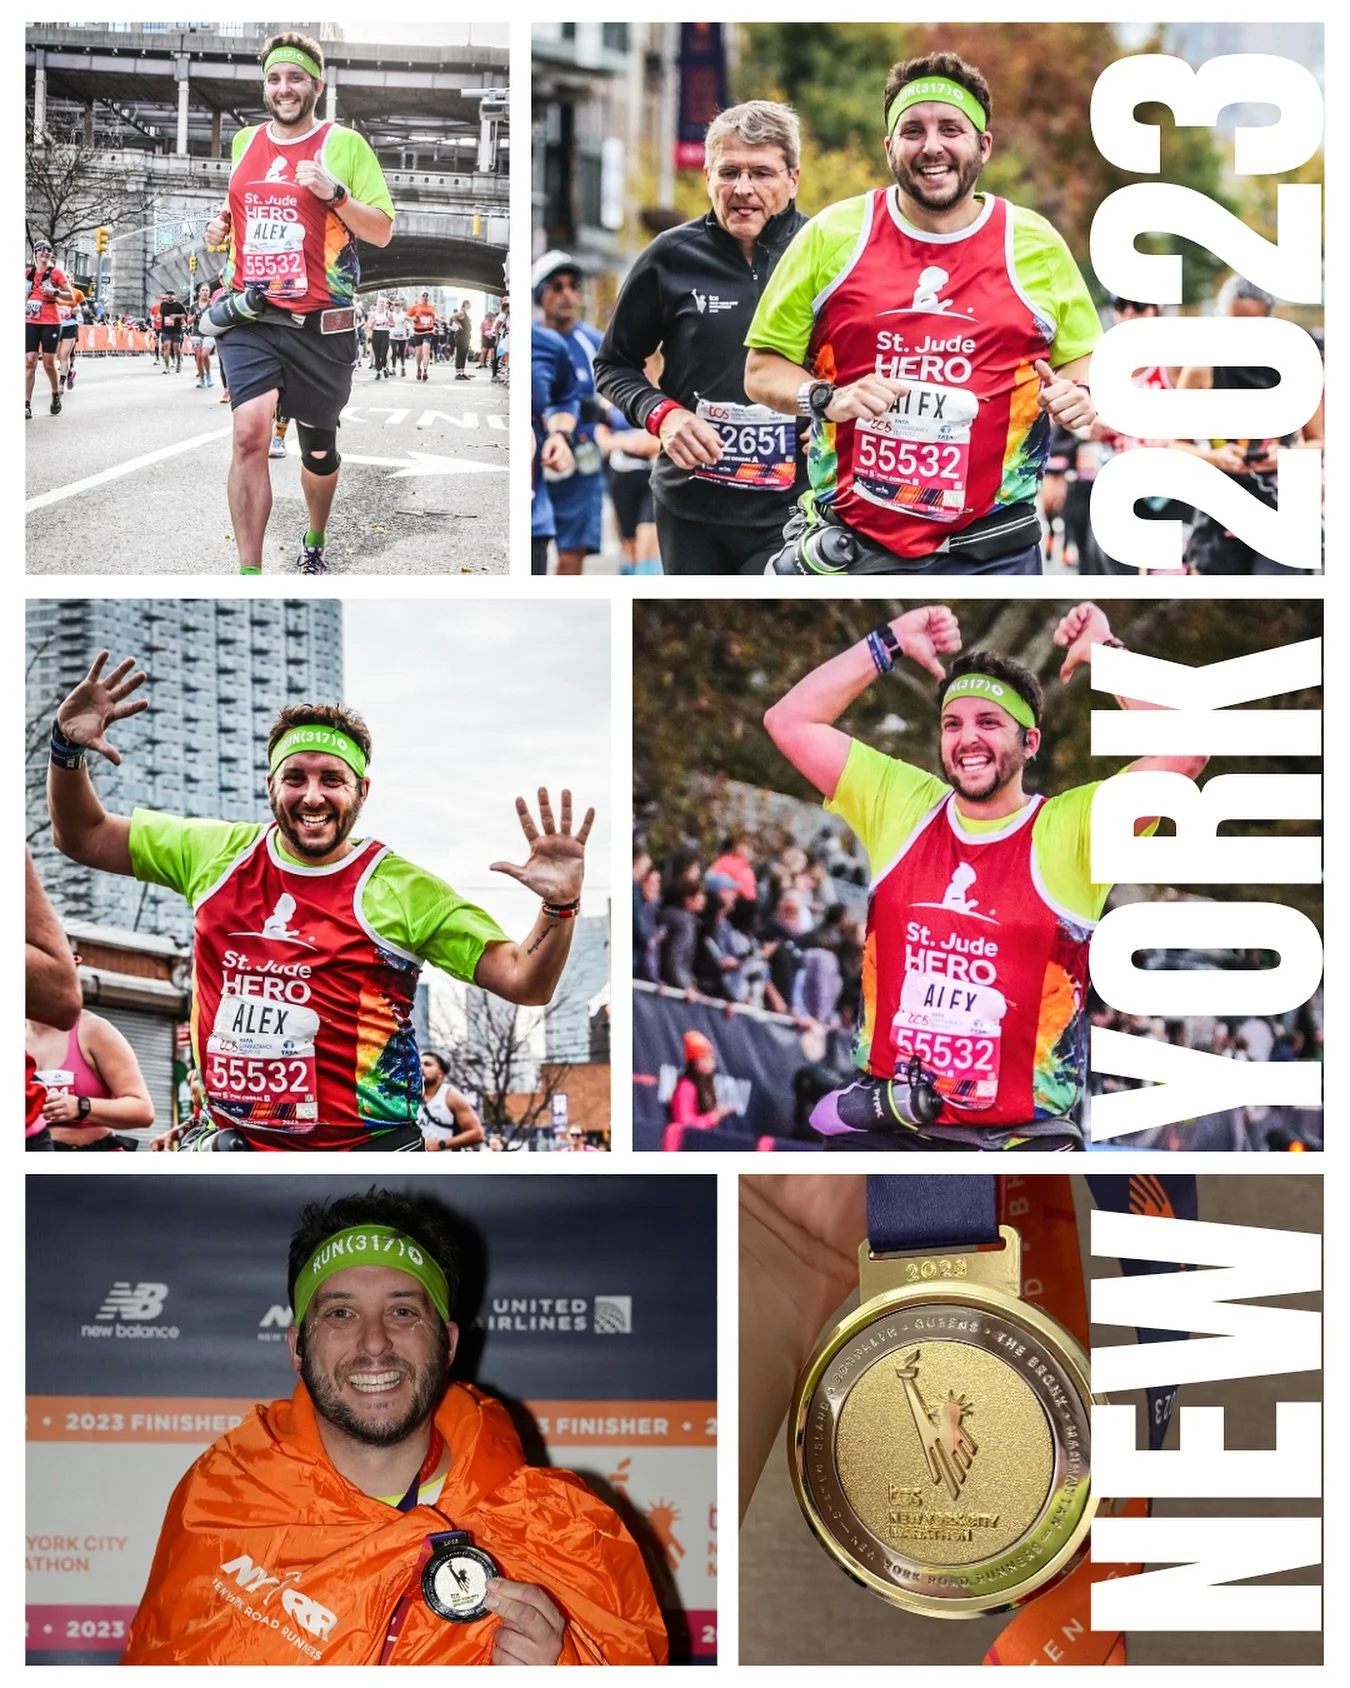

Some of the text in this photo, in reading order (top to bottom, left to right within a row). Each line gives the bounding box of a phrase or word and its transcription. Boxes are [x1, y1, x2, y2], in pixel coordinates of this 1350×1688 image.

[245, 193, 297, 206] St. Jude
[245, 206, 298, 221] HERO
[254, 223, 288, 240] ALEX
[246, 253, 302, 275] 55532
[876, 331, 976, 354] St. Jude
[875, 353, 972, 383] HERO
[709, 405, 729, 420] tcs
[711, 424, 786, 455] 2651
[860, 434, 961, 479] 55532
[906, 922, 998, 957] St. Jude
[222, 950, 312, 979] St. Jude
[905, 945, 997, 985] HERO
[220, 970, 312, 1004] HERO
[232, 1004, 289, 1035] ALEX
[897, 1029, 994, 1070] 55532
[211, 1056, 309, 1093] 55532
[312, 1234, 405, 1274] RUN(317)
[905, 1259, 968, 1282] 2023
[493, 1299, 587, 1313] UNITED
[81, 1322, 180, 1339] new balance
[912, 1315, 979, 1332] QUEENS
[66, 1414, 124, 1431] 2023
[556, 1417, 669, 1435] FINISHER
[26, 1534, 127, 1552] YORK CITY
[66, 1620, 125, 1638] 2023
[244, 1606, 280, 1629] ROAD
